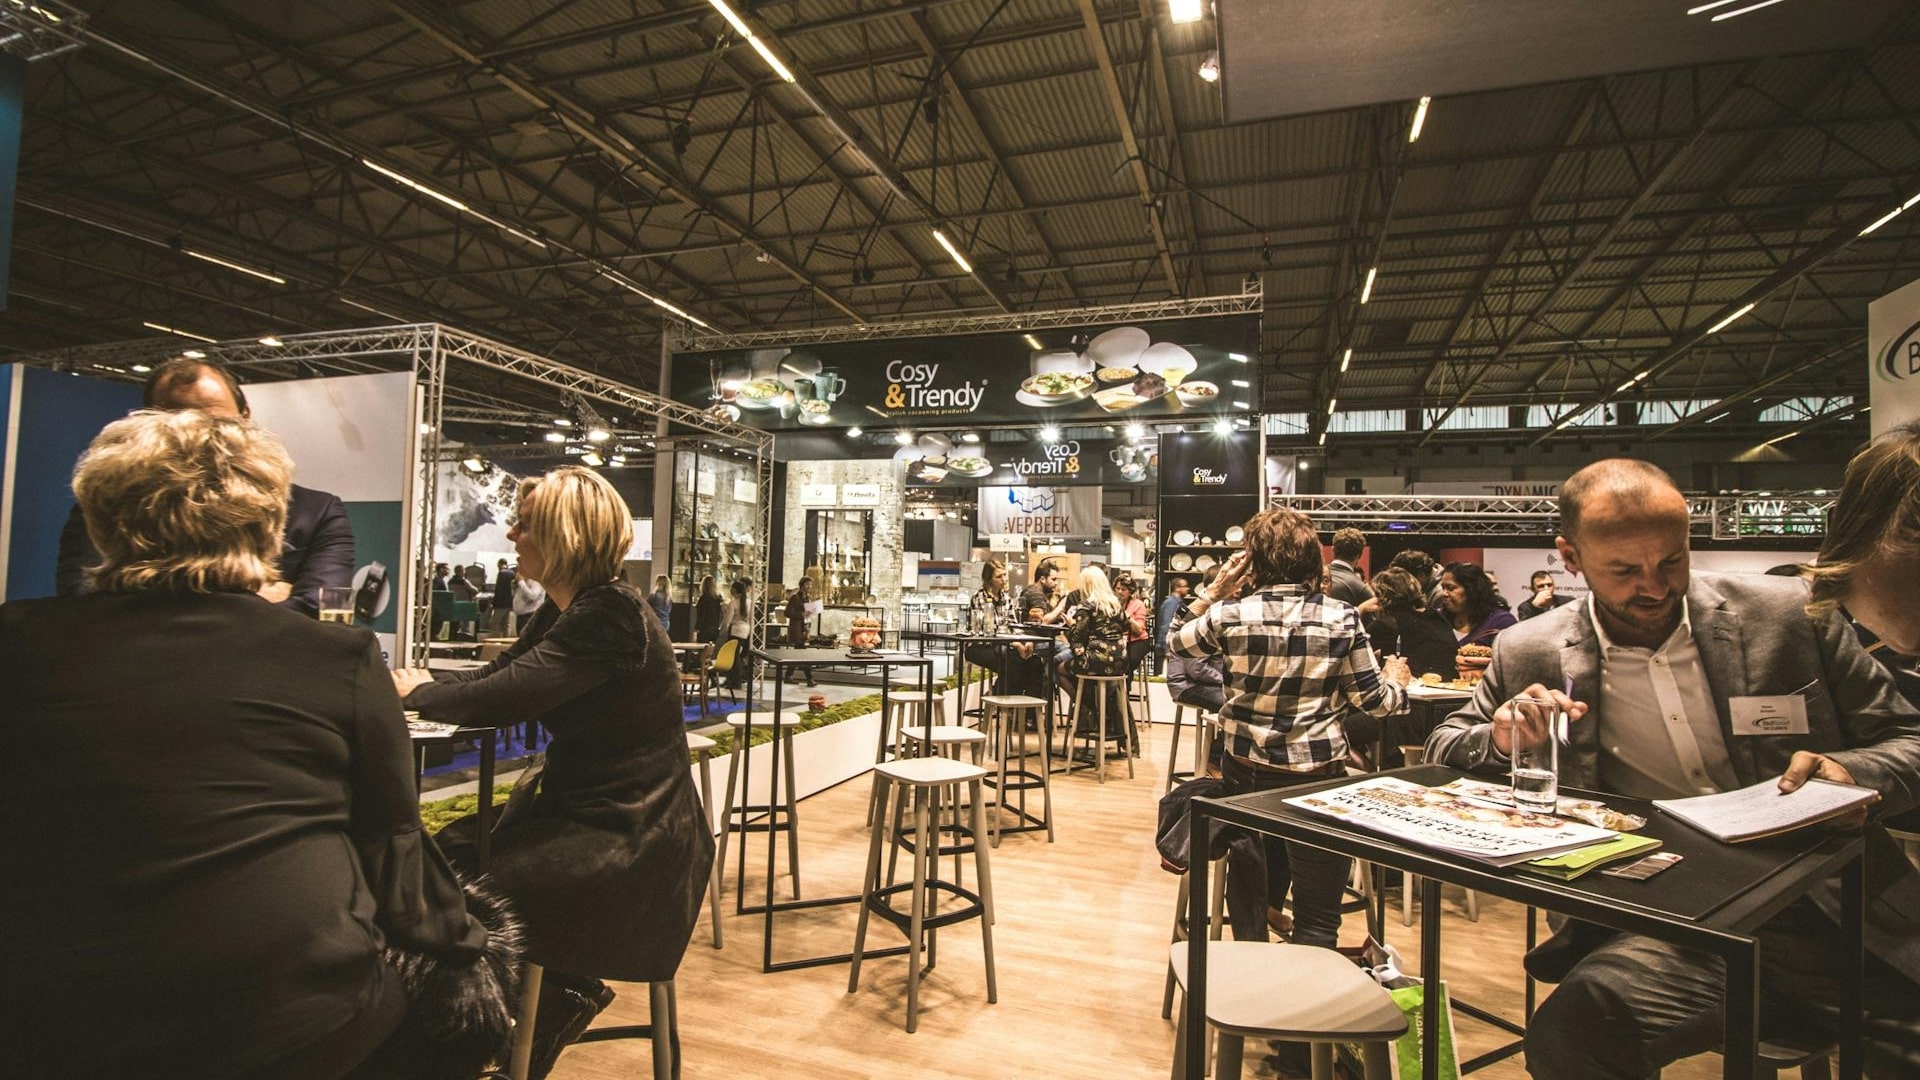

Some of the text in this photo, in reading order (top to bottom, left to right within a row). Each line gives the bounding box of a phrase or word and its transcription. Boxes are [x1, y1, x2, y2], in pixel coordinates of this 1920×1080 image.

[886, 360, 939, 388] Cosy
[885, 381, 985, 412] & Trendy
[1193, 467, 1212, 478] Cosy
[1200, 473, 1228, 484] Trendy
